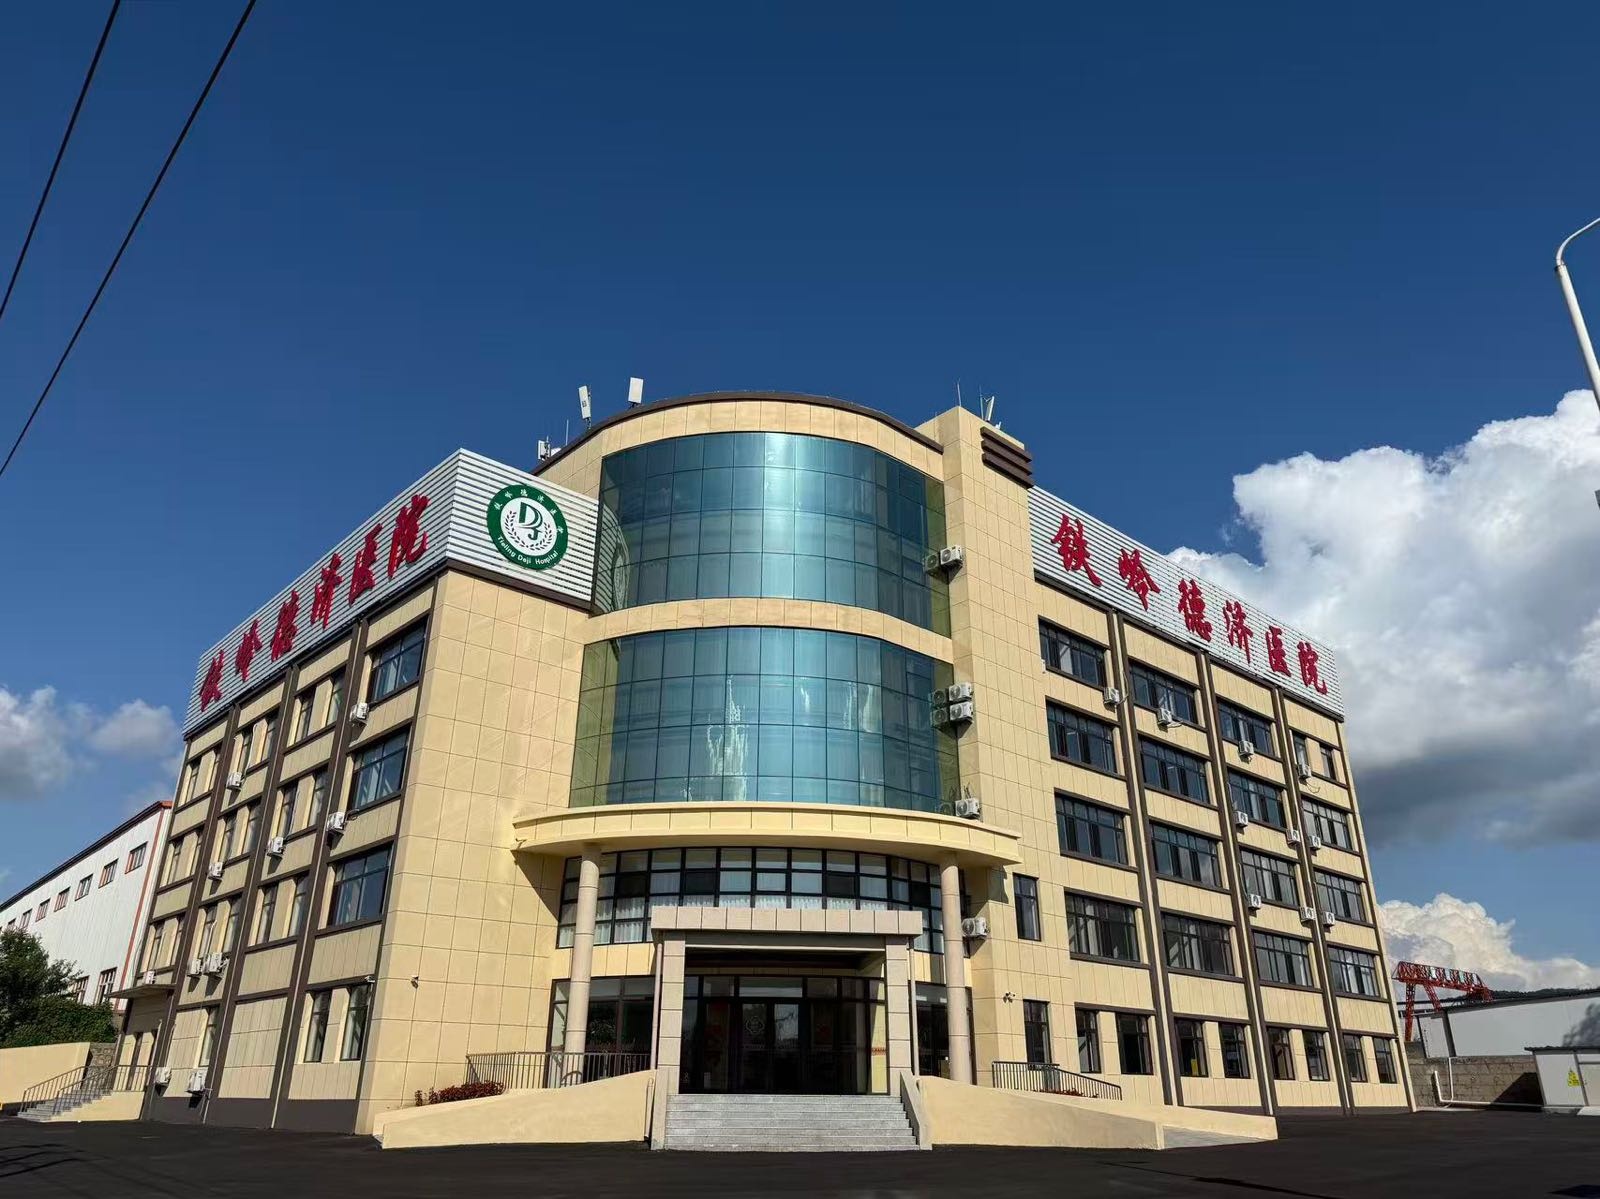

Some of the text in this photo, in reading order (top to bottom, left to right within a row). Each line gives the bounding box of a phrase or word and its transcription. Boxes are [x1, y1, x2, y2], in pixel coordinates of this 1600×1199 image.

[497, 535, 517, 558] Tieling
[534, 550, 559, 565] Hospital
[1051, 514, 1328, 694] 铁岭德济医院
